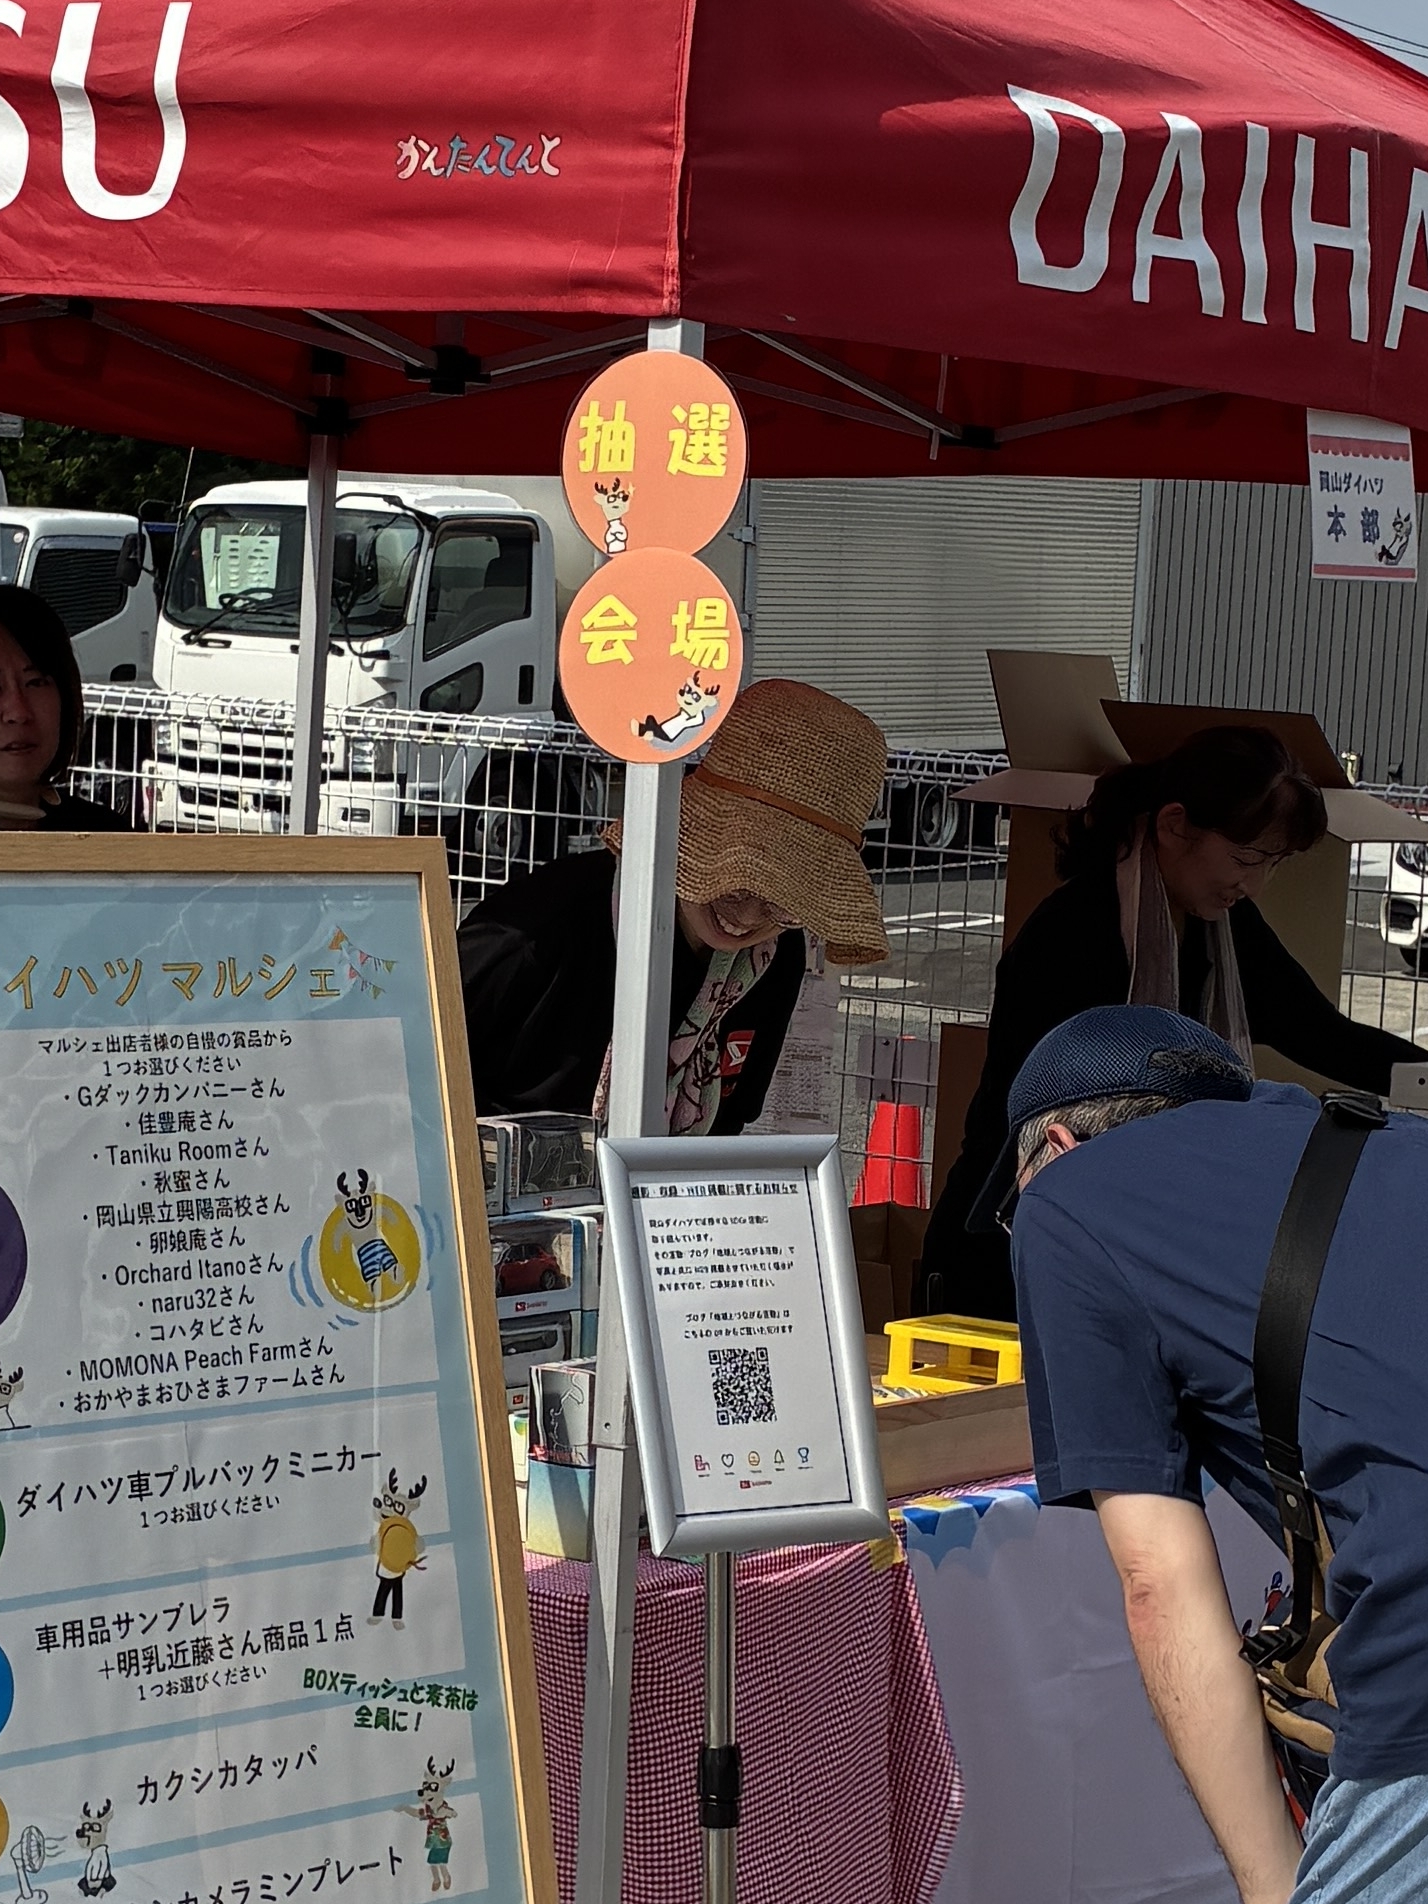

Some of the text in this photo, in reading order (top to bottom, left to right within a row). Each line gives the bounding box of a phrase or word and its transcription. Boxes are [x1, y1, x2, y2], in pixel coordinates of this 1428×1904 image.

[396, 134, 562, 179] かんたんてんと
[578, 399, 731, 477] 抽選
[1319, 470, 1384, 495] 岡山ダイハツ
[1327, 504, 1380, 544] 本部
[579, 594, 731, 671] 会場
[161, 953, 341, 1002] マルシェ
[184, 1344, 243, 1370] Peach
[248, 1335, 333, 1365] Farmさん
[17, 1444, 382, 1518] ダイハツ車プルバックミニカー
[35, 1596, 230, 1653] 車用品サンブレラ
[137, 1744, 318, 1805] カクシカタッパ
